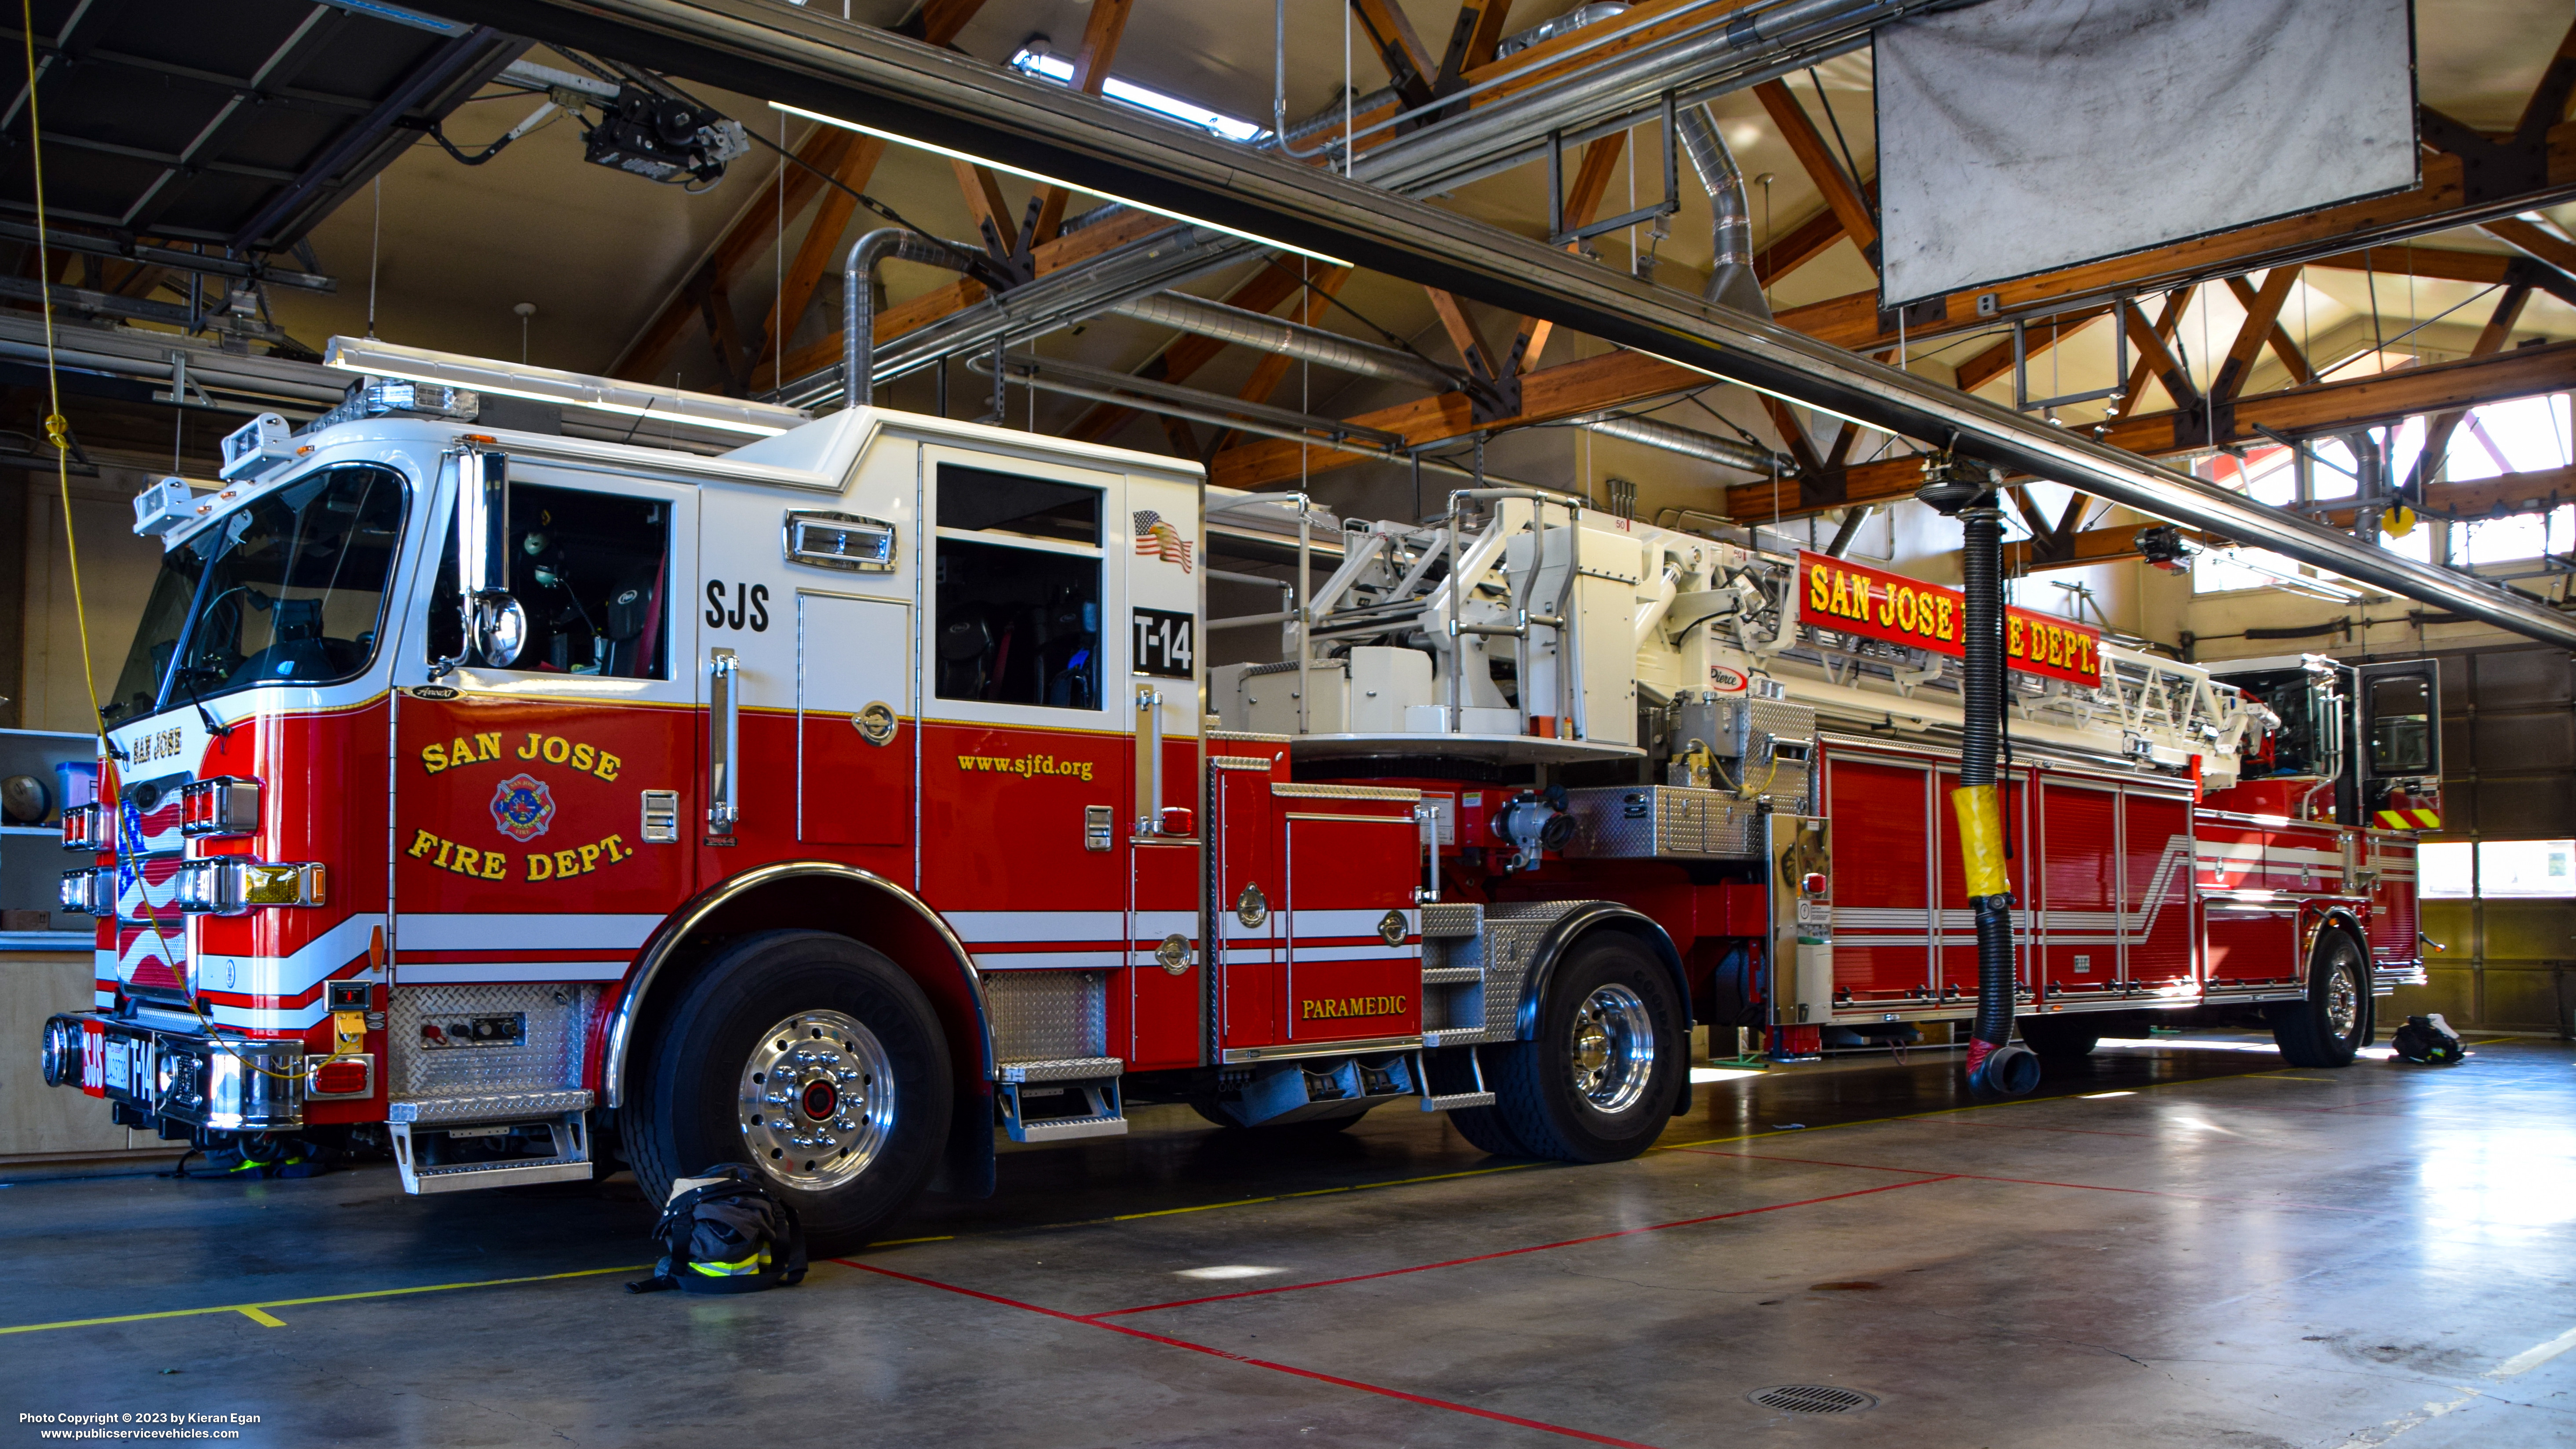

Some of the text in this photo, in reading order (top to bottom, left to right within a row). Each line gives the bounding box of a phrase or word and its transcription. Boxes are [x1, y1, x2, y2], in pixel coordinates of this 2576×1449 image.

[1616, 519, 1625, 529] 50
[706, 579, 769, 632] SJS
[1810, 564, 1871, 622] SAN
[1879, 583, 1954, 641] JOSE
[2030, 620, 2096, 675] DEPT.
[1135, 615, 1192, 669] T-14
[133, 726, 182, 765] SAN JOSE
[421, 732, 622, 782] SAN JOSE
[957, 754, 1093, 781] www.sjfd.org
[408, 829, 633, 881] FIRE DEPT.
[1302, 995, 1406, 1019] PARAMEDIC
[83, 1032, 103, 1089] SJS
[131, 1038, 153, 1101] T-14
